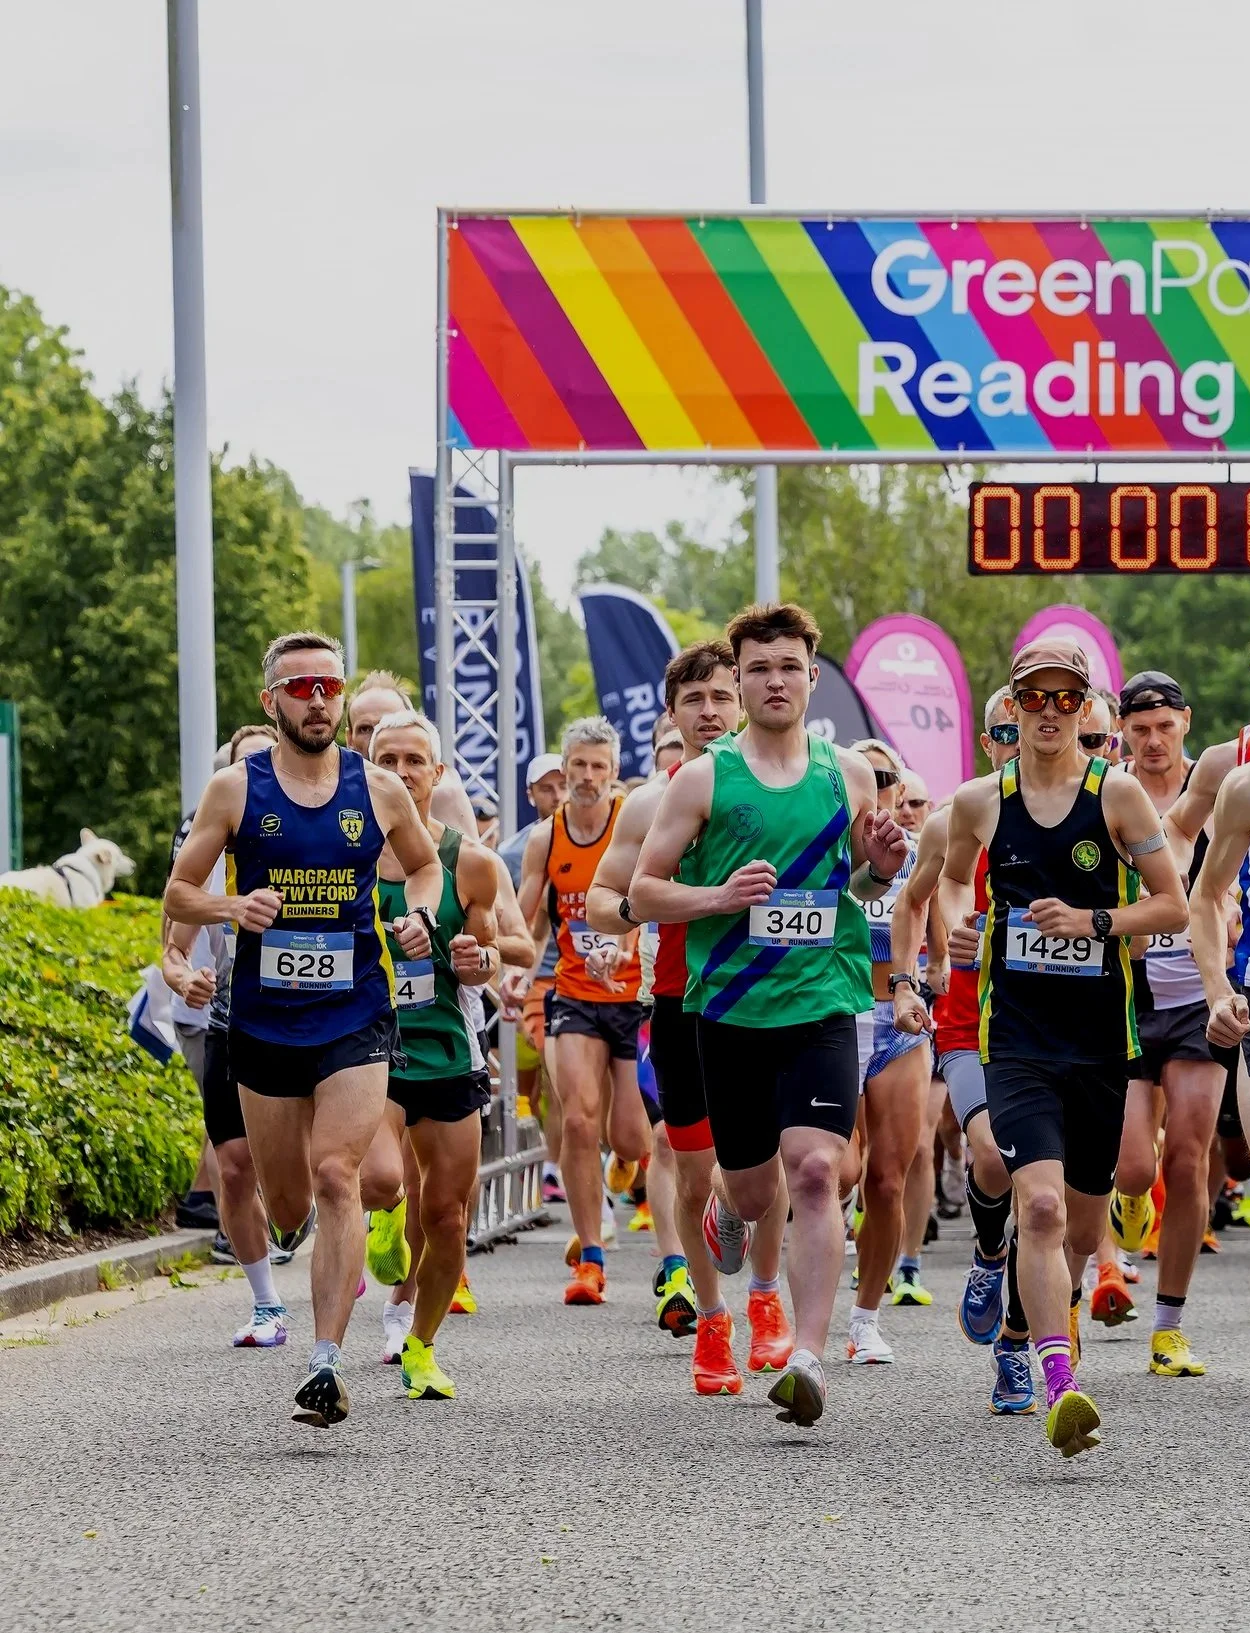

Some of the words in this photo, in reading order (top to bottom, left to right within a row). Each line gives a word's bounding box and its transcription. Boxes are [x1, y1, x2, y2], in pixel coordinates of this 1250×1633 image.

[858, 341, 1235, 438] Reading
[453, 606, 497, 803] RUNNIN
[268, 868, 355, 884] WARGRAVE
[281, 885, 358, 901] TWYFORD
[286, 906, 335, 916] RUNNERS
[766, 910, 822, 935] 340
[1015, 932, 1092, 962] 1429
[276, 952, 335, 978] 628
